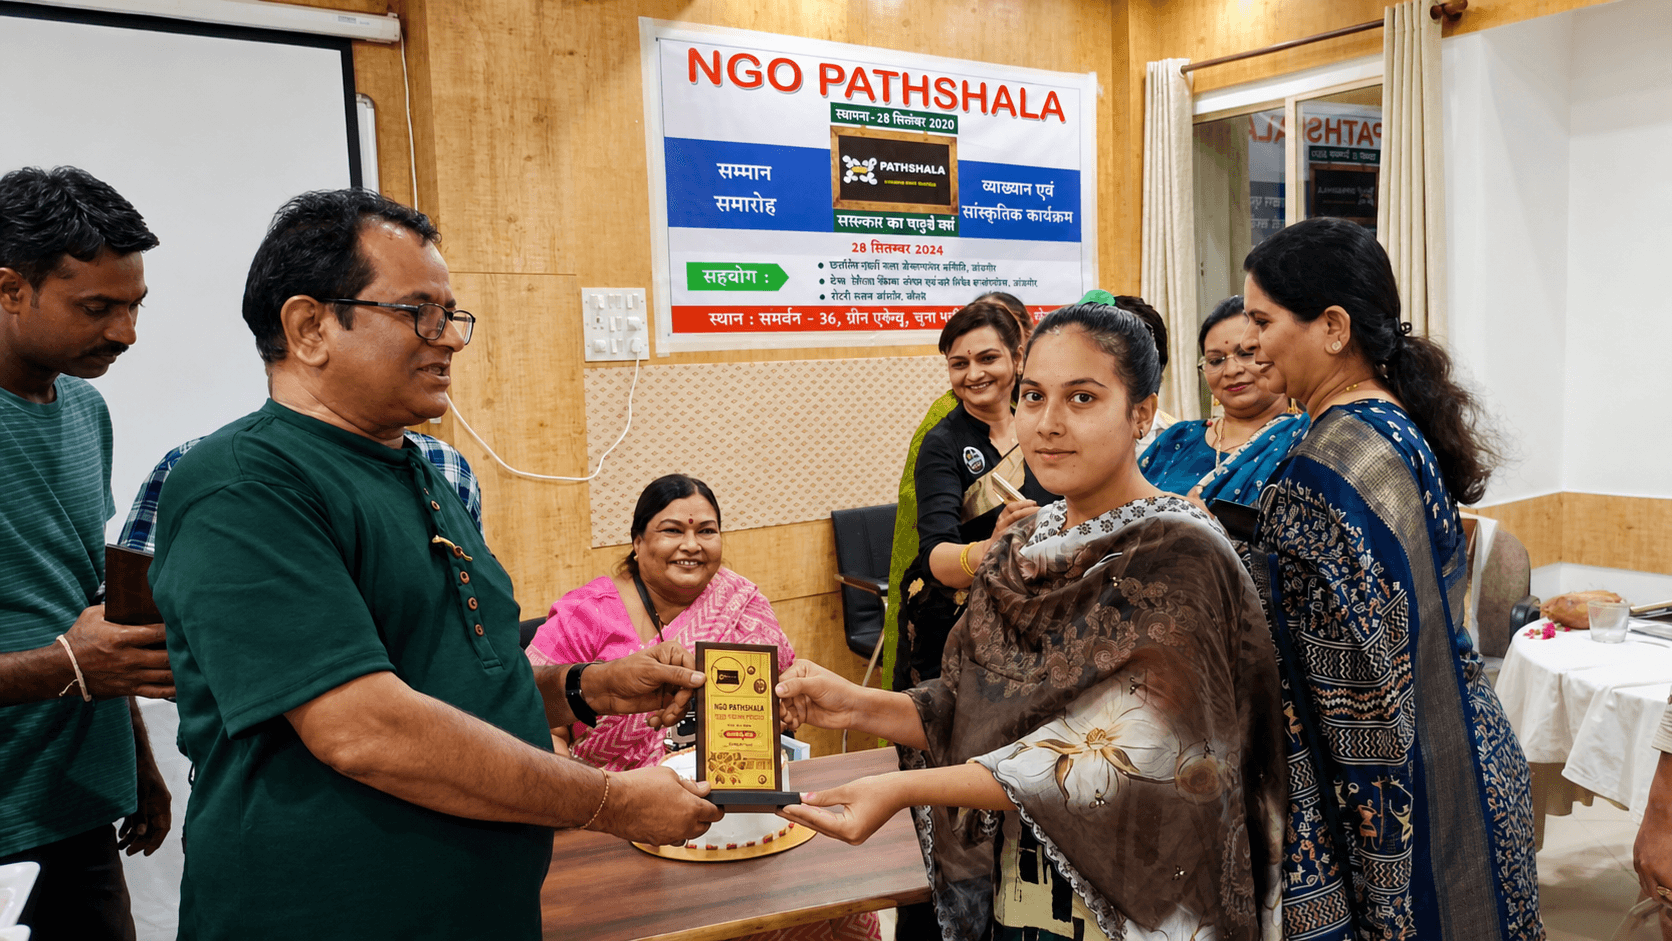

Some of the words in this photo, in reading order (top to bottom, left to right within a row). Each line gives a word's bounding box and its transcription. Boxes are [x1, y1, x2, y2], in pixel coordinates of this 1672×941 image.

[688, 47, 801, 92] NGO
[819, 62, 1066, 123] PATHSHALA
[877, 112, 890, 124] 28
[929, 118, 955, 130] 2020
[716, 163, 772, 181] सम्मान
[880, 161, 946, 176] PATHSHALA
[981, 180, 1032, 196] व्याख्यान
[1035, 180, 1055, 201] एवं
[713, 191, 777, 216] समारोह
[961, 201, 1023, 224] सांस्कृतिक
[1026, 205, 1074, 224] कार्यक्रम
[886, 217, 904, 230] का
[852, 242, 867, 253] 28
[915, 245, 943, 256] 2024
[708, 311, 744, 326] स्थान
[819, 312, 842, 327] 36,
[845, 307, 869, 326] ग्रीन
